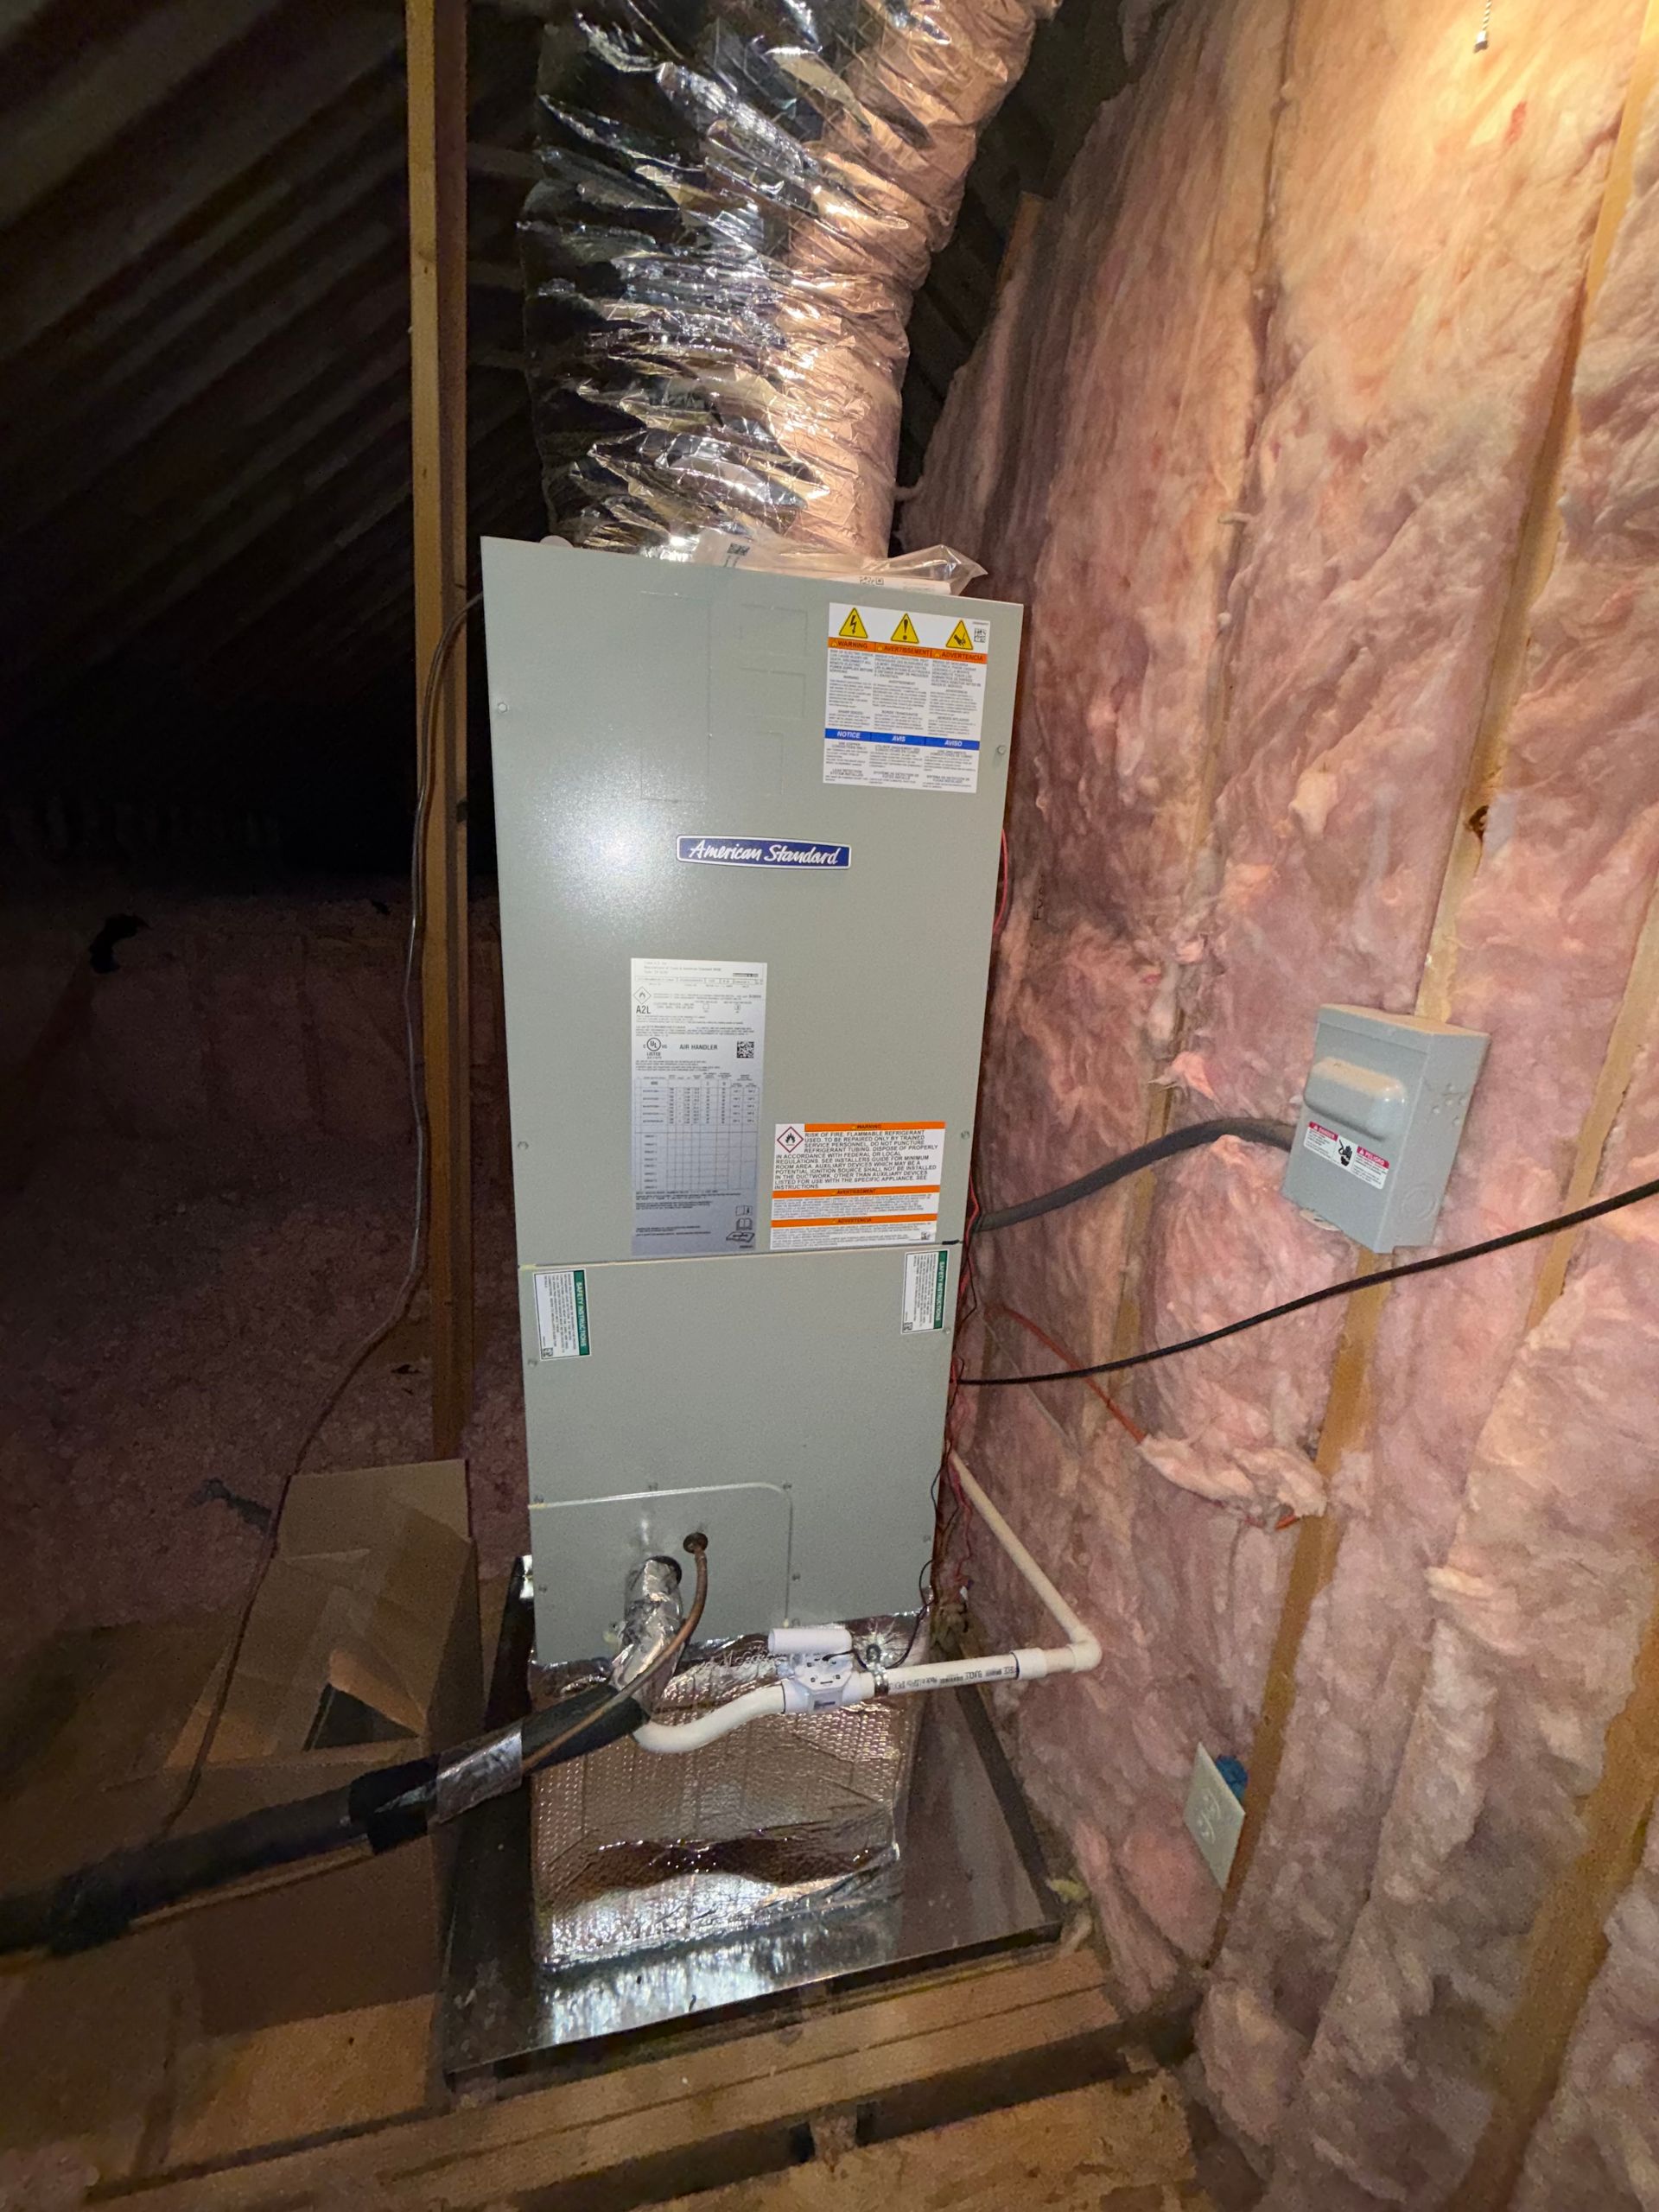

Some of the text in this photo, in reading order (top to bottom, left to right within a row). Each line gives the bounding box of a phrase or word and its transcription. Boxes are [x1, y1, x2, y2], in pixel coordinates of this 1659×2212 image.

[838, 640, 868, 649] WARNING
[884, 645, 930, 655] AVERTISSEMENT
[942, 652, 983, 661] ADVERTENCIA
[836, 730, 861, 739] NOTICE
[689, 839, 842, 865] American Standard
[636, 1005, 651, 1014] A2L
[935, 1282, 944, 1321] INSTRUCTIONS
[575, 1281, 587, 1347] SAFETY INSTRUCTIONS
